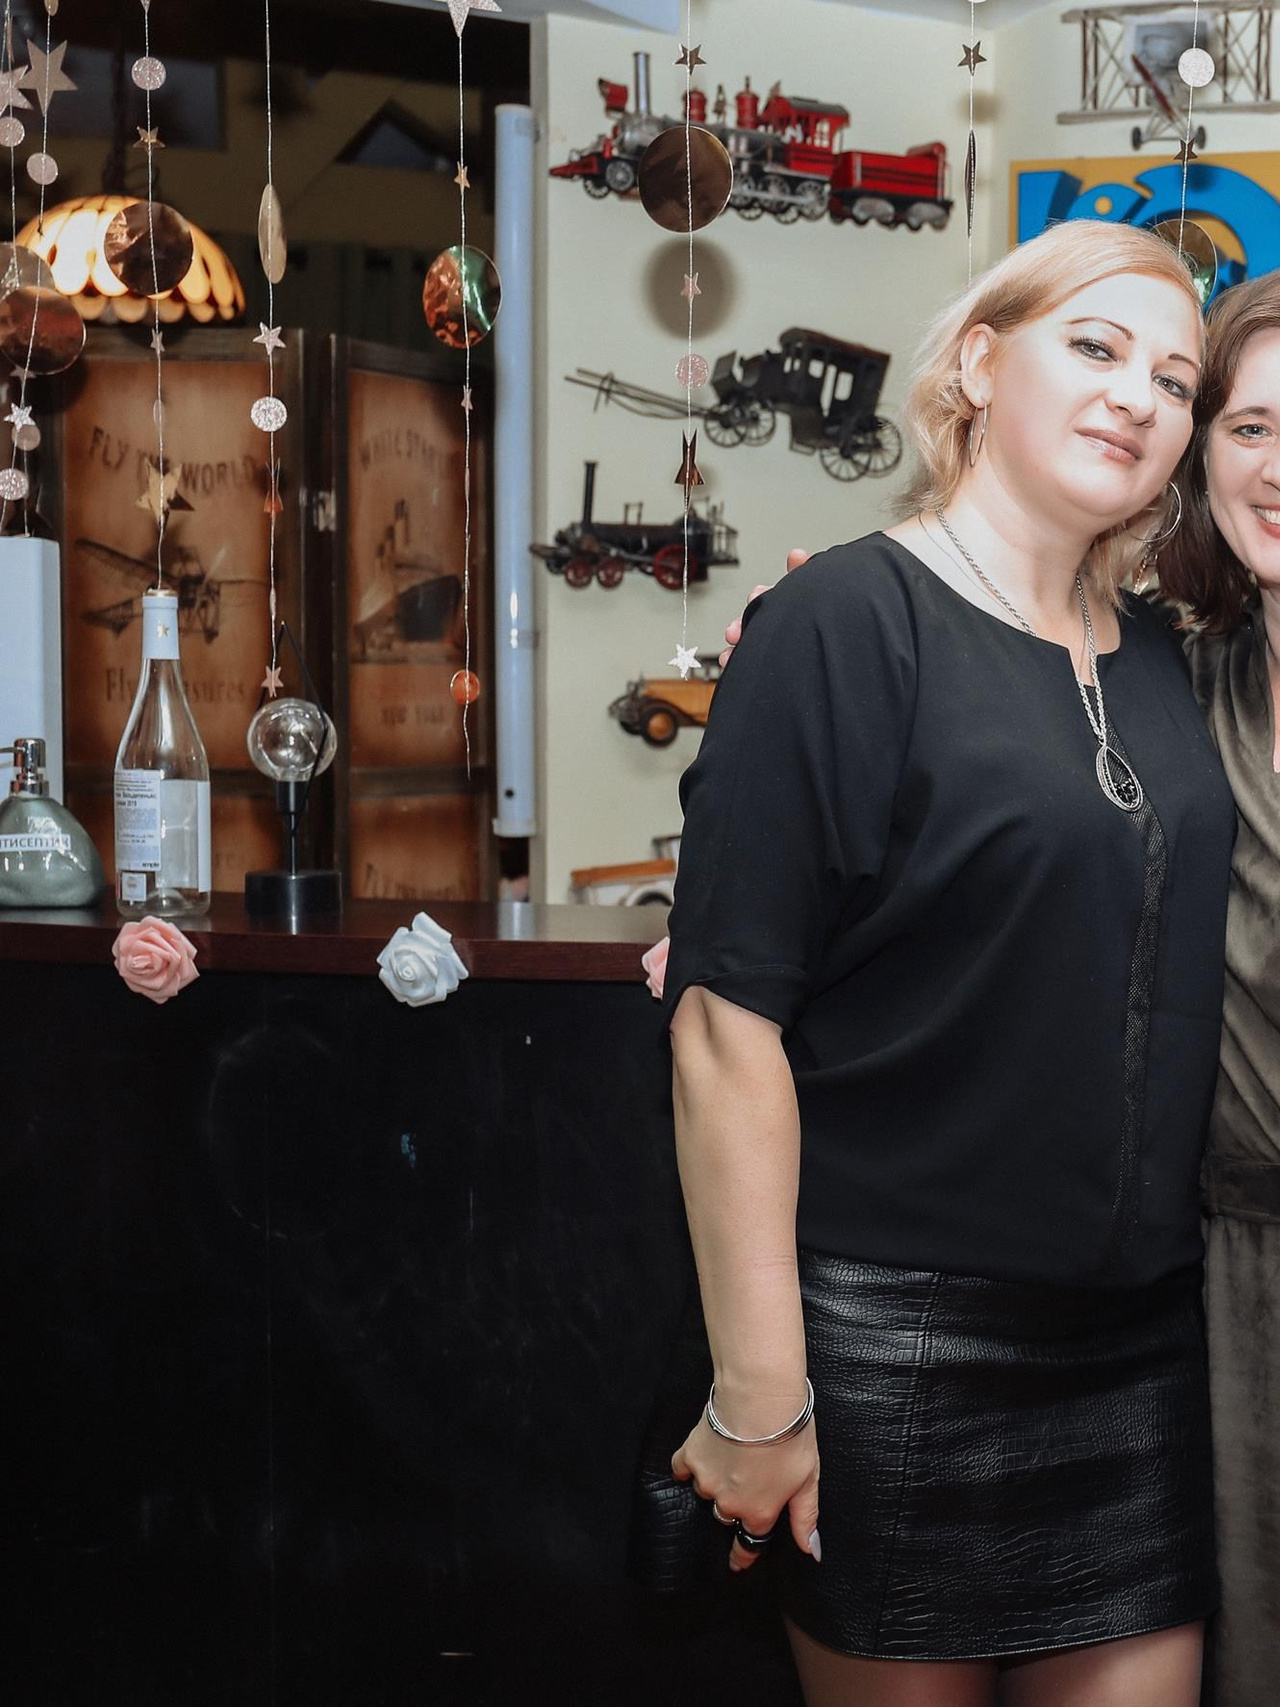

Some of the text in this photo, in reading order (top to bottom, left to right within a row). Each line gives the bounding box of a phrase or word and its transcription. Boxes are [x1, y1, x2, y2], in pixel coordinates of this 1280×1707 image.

[88, 425, 130, 472] FLY
[180, 455, 256, 496] WORLD
[0, 837, 69, 848] ТИСЕПТИК
